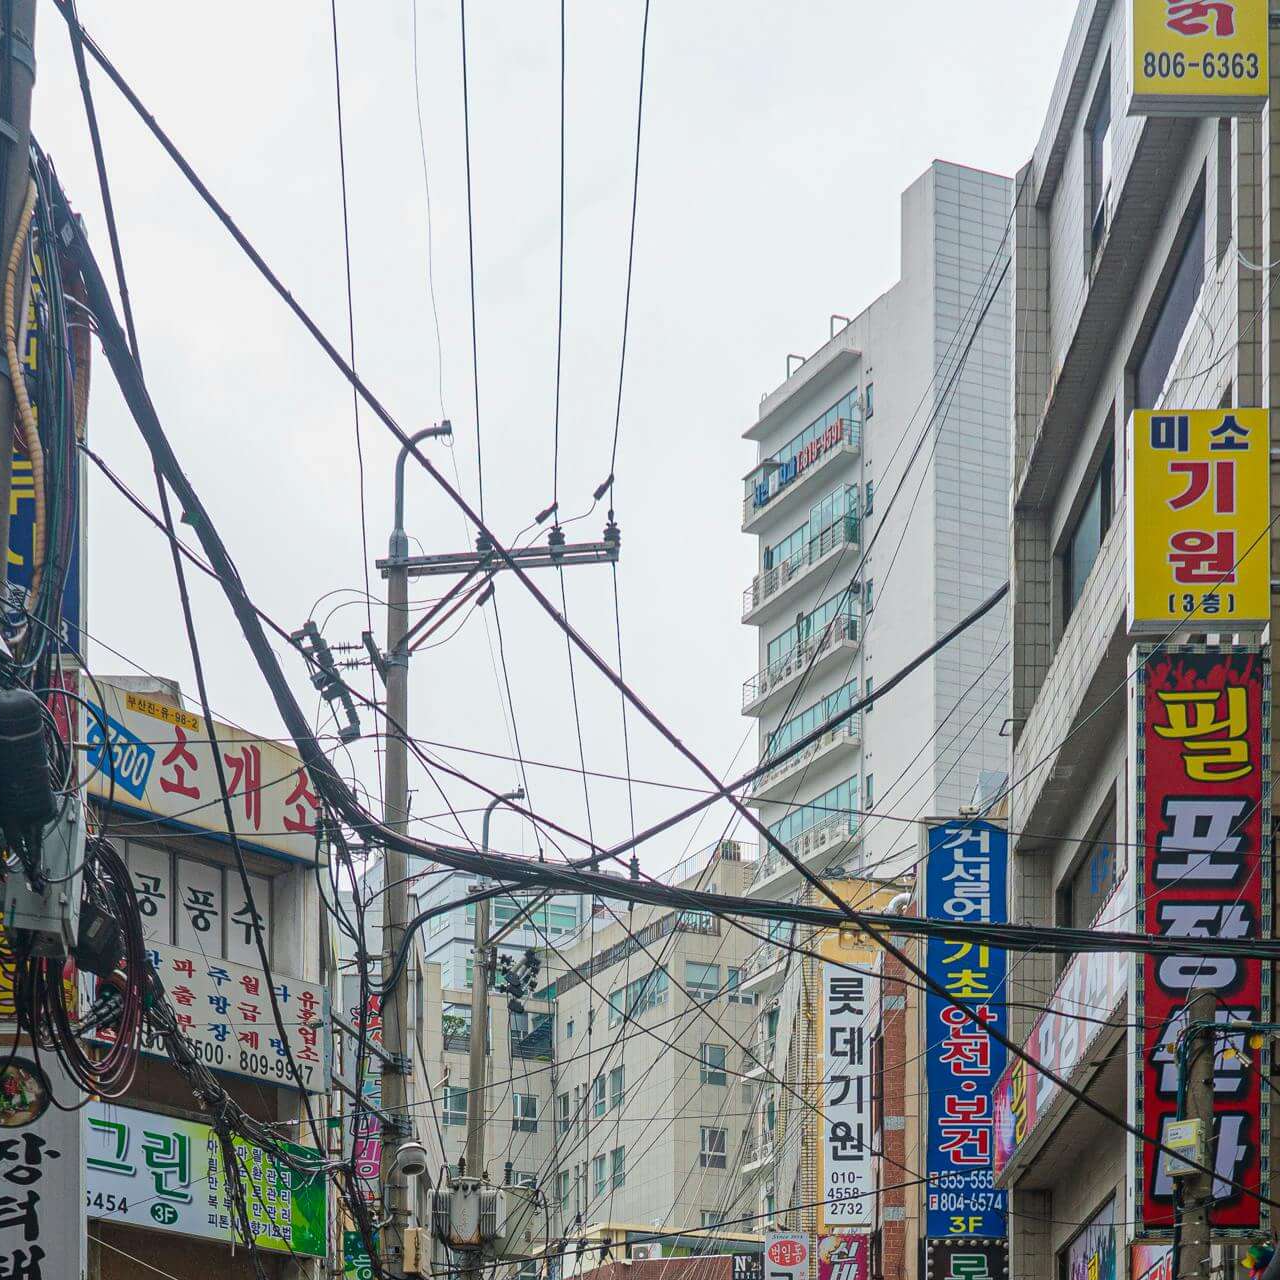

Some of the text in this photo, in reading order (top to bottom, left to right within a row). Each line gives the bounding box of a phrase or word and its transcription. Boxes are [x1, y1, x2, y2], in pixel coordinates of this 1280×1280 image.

[1144, 51, 1260, 79] 806-6363
[1150, 415, 1250, 452] 미소
[1167, 460, 1237, 584] 기원
[1155, 686, 1252, 781] 필
[829, 977, 865, 1162] 롯데기원
[831, 1202, 863, 1215] 2732
[949, 1217, 983, 1233] 3F
